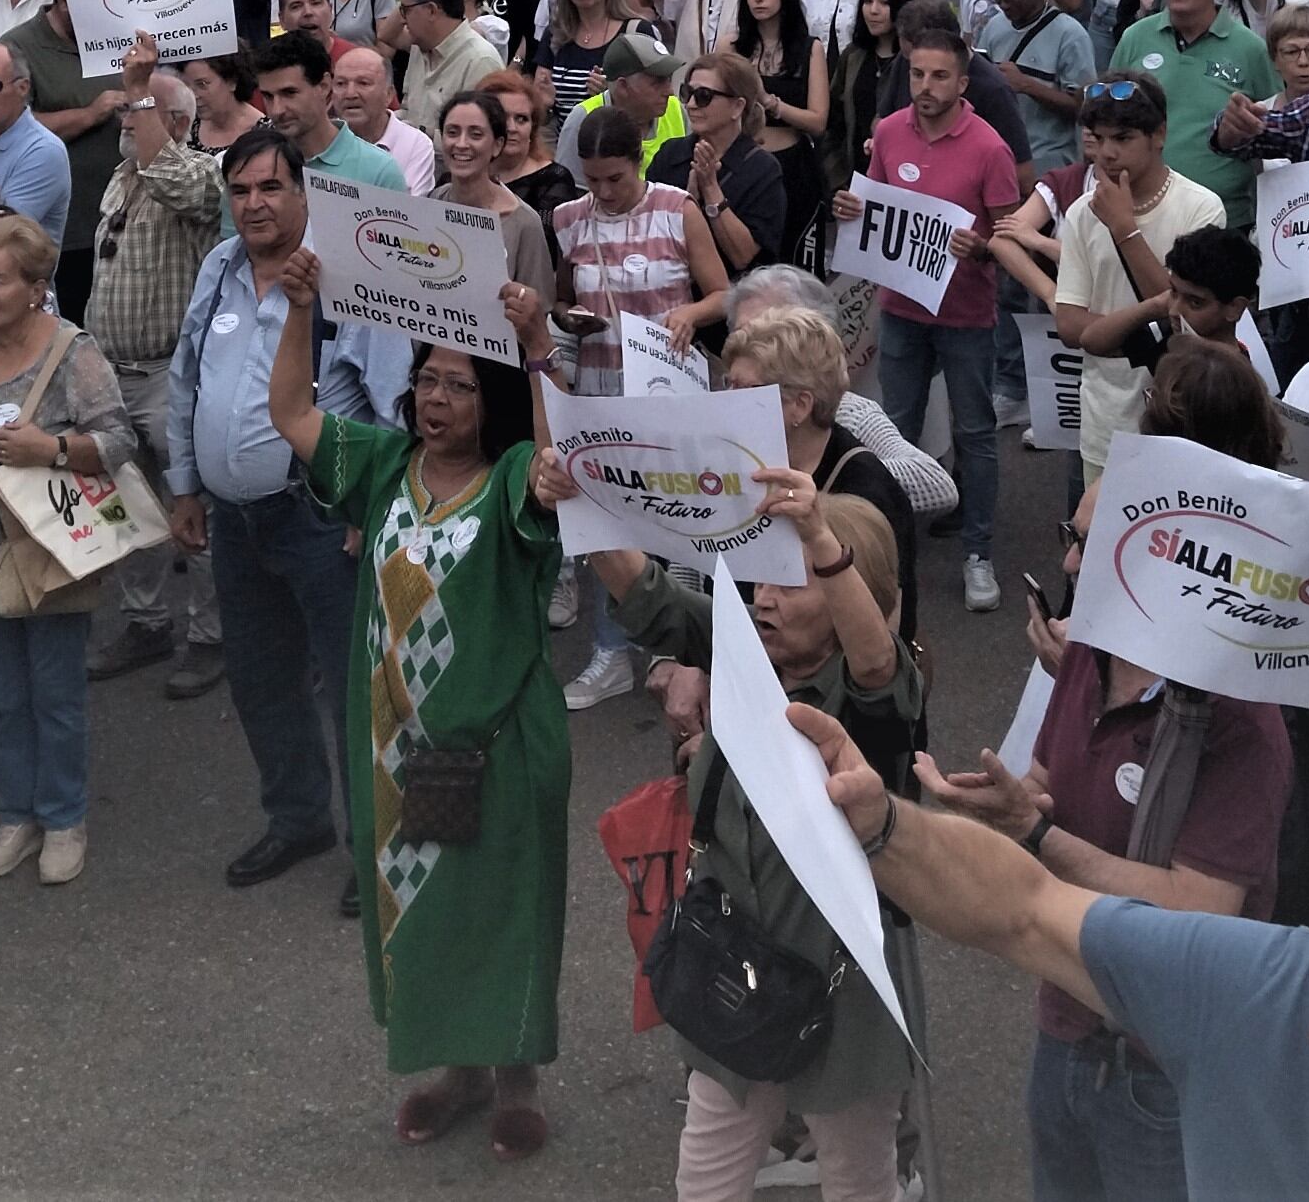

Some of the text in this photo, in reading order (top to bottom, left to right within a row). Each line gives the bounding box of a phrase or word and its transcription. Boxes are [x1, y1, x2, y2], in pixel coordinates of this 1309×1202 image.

[84, 39, 103, 53] Mis
[106, 36, 132, 53] hijos
[200, 21, 228, 35] más
[309, 175, 360, 199] #SIALAFUSION
[354, 206, 408, 223] Don Benito
[444, 210, 495, 231] #SIALFUTURO
[1271, 204, 1287, 227] Don
[909, 212, 952, 252] SIÓN
[396, 249, 434, 269] Futuro
[908, 243, 948, 282] TURO
[419, 274, 467, 292] Villanueva
[353, 283, 479, 328] Quiero a mis
[332, 298, 509, 356] nietos cerca de mí
[556, 427, 633, 456] Don Benito
[48, 479, 82, 526] Yo
[640, 494, 718, 520] Futuro
[1122, 489, 1248, 522] Don Benito
[690, 514, 773, 555] Villanueva
[1205, 586, 1306, 631] Futuro
